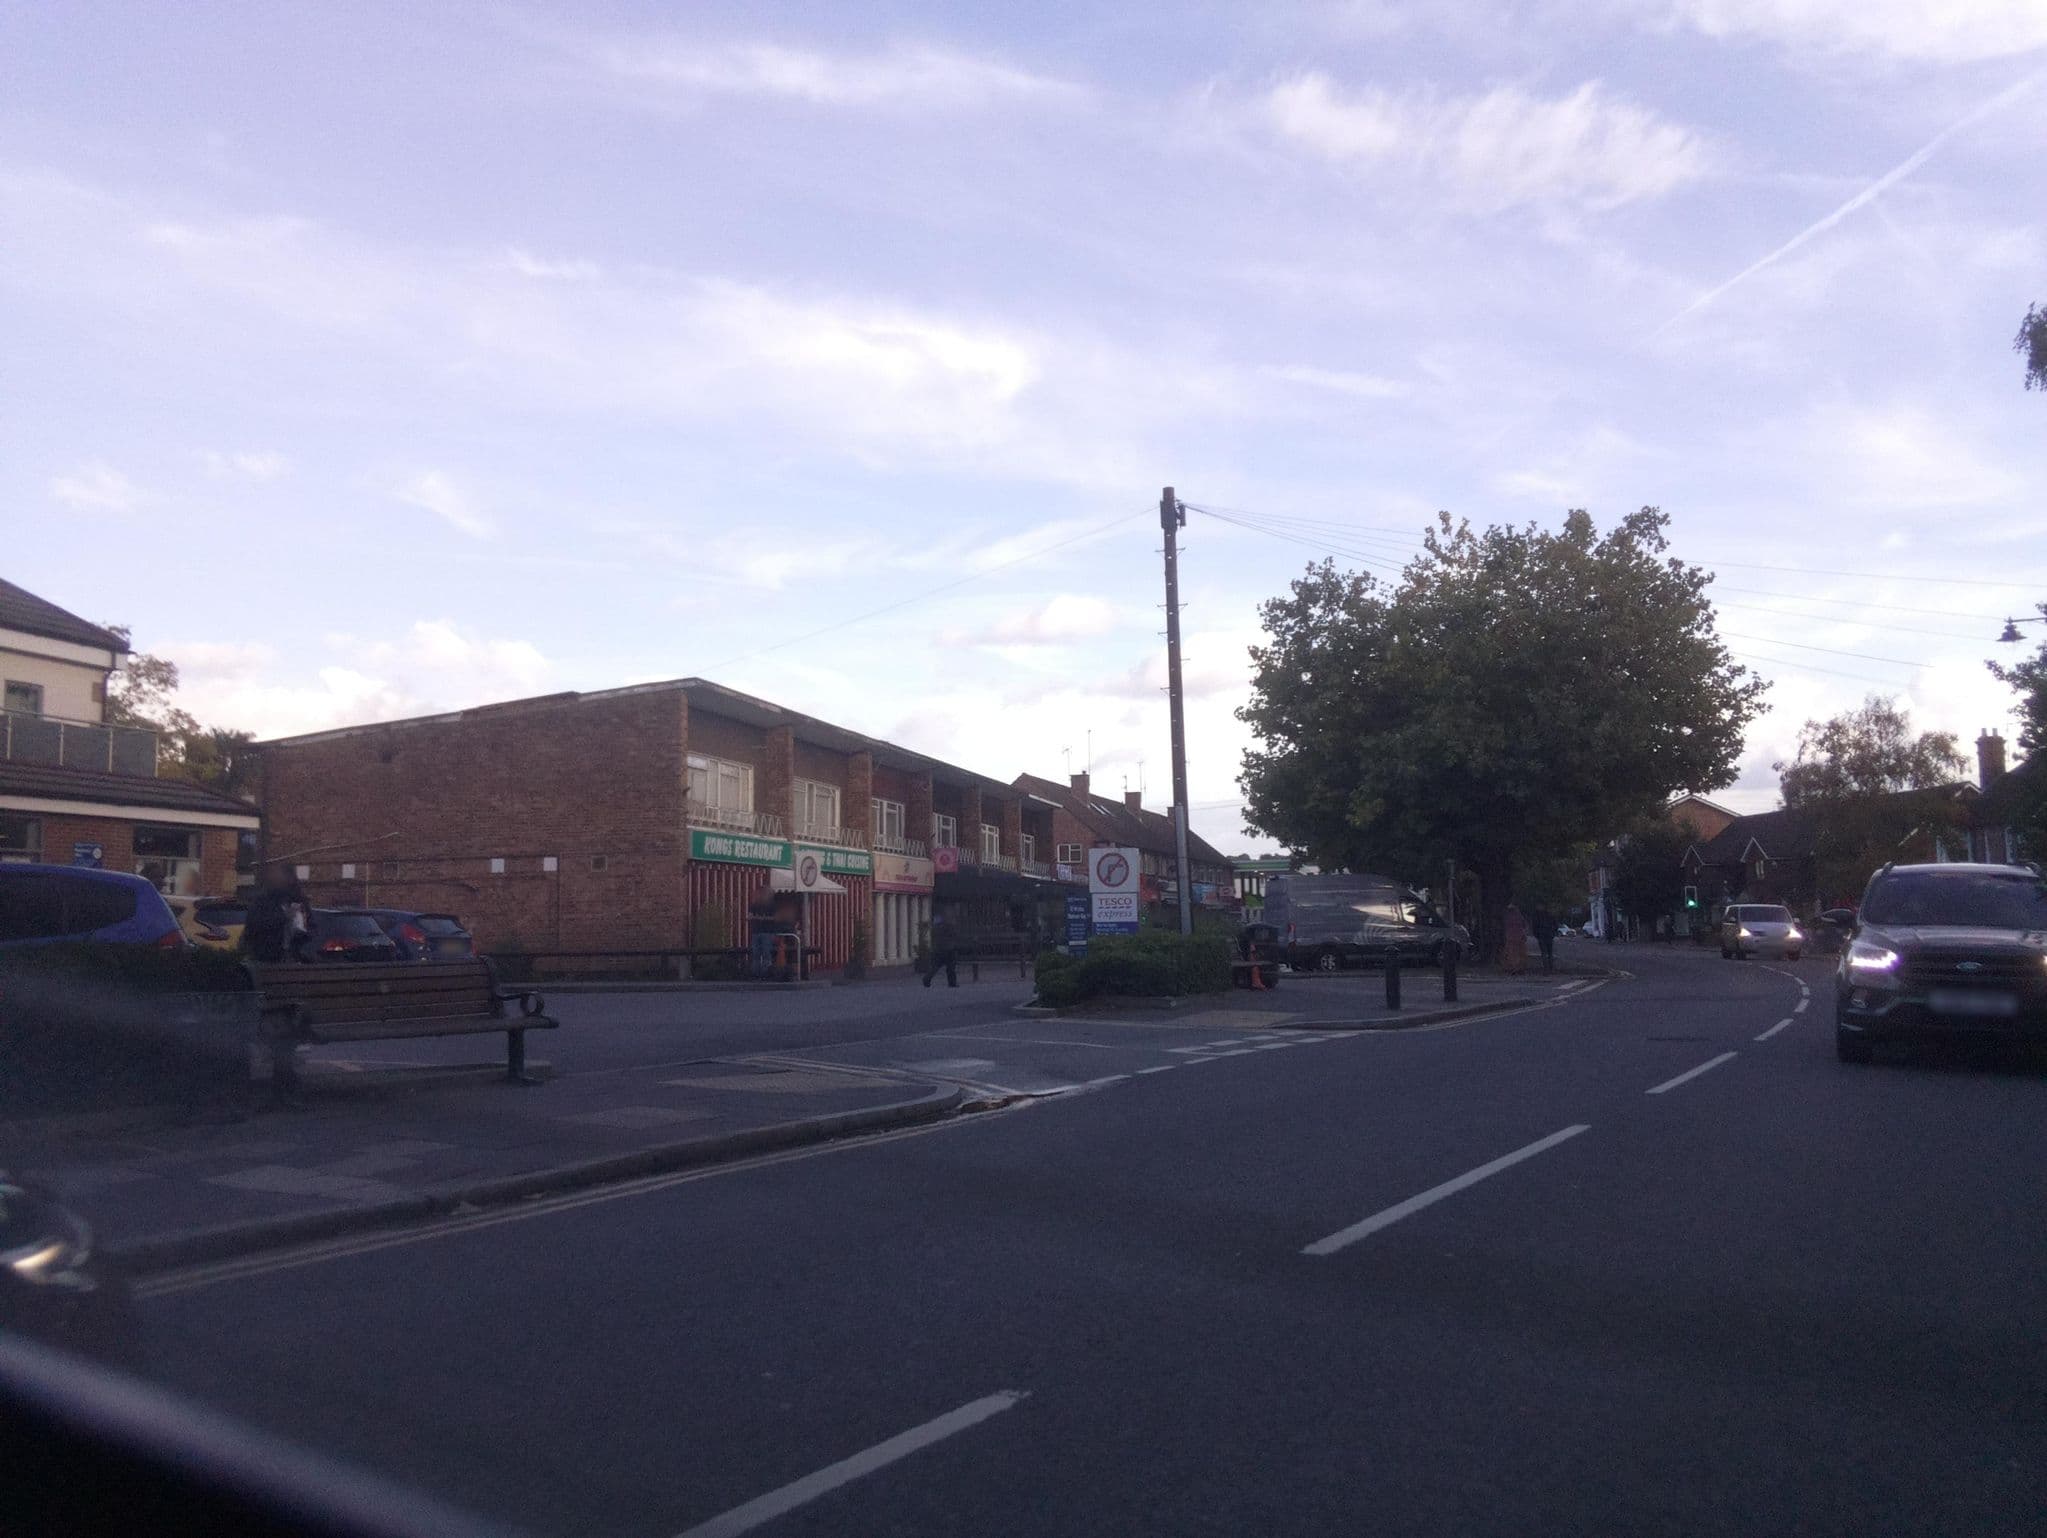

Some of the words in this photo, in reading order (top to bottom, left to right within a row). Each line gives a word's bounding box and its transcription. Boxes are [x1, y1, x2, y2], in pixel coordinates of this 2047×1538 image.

[704, 836, 733, 856] KONGS
[734, 840, 783, 861] RESTAURANT
[1099, 897, 1132, 905] TESCO
